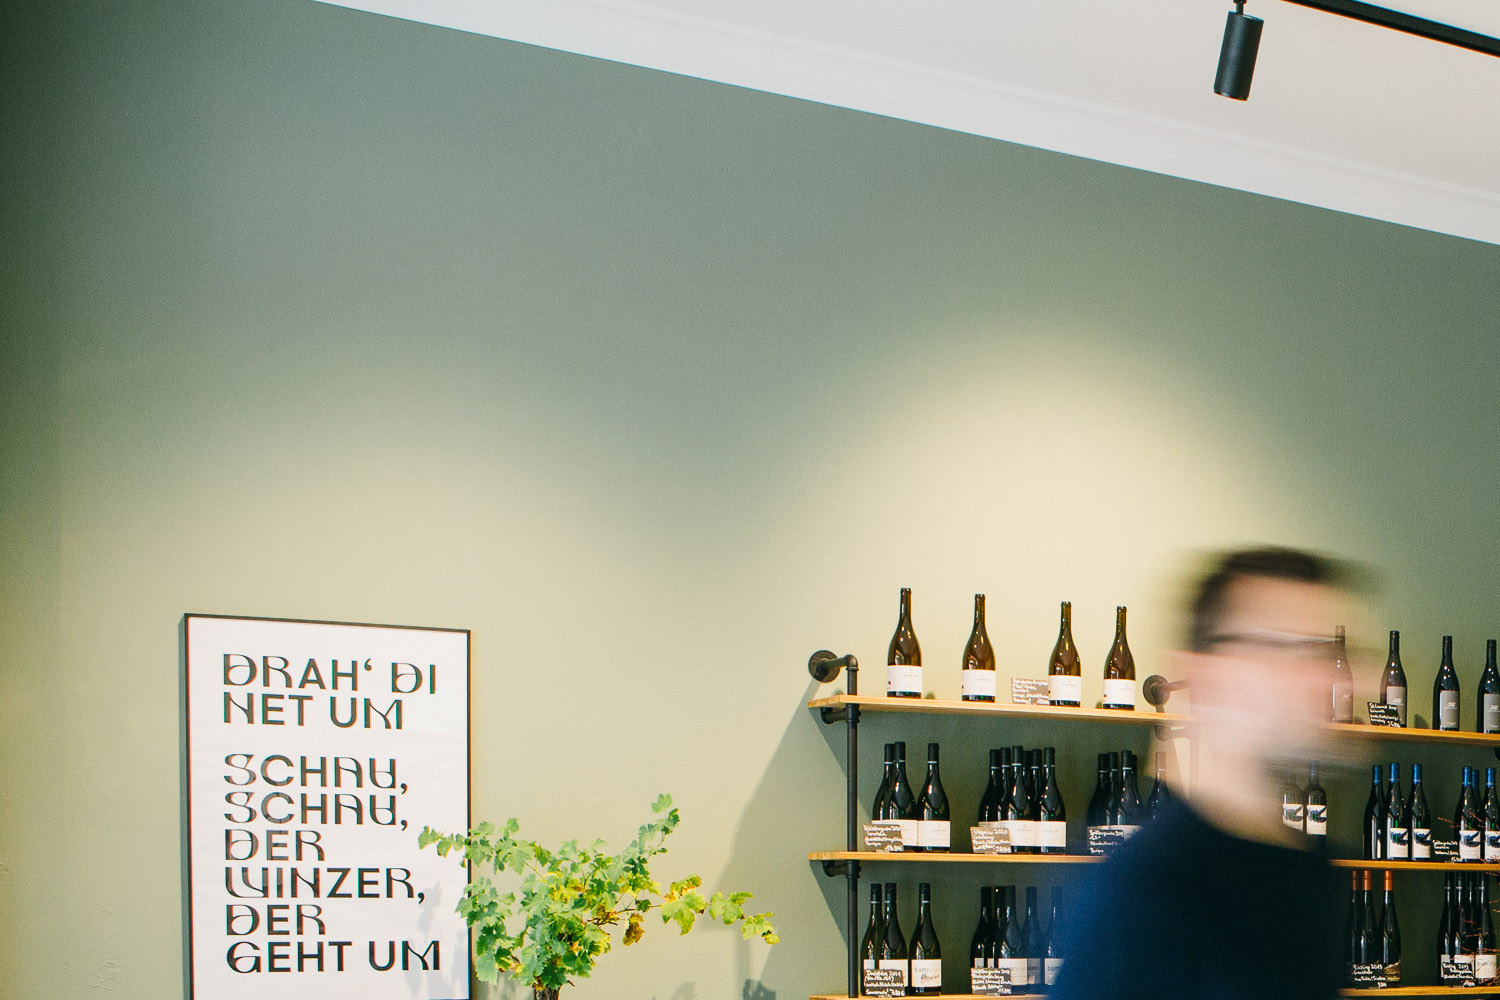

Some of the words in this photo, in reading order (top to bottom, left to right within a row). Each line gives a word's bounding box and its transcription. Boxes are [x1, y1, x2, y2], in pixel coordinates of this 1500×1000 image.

[391, 662, 436, 695] DI
[223, 692, 314, 726] NET
[330, 696, 403, 730] UM
[223, 753, 408, 795] SCHAU,
[224, 791, 408, 831] SCHAU,
[224, 829, 325, 861] DER
[225, 866, 425, 904] WINZER,
[226, 904, 326, 935] DER
[226, 941, 353, 974] GEHT
[368, 940, 440, 972] UM
